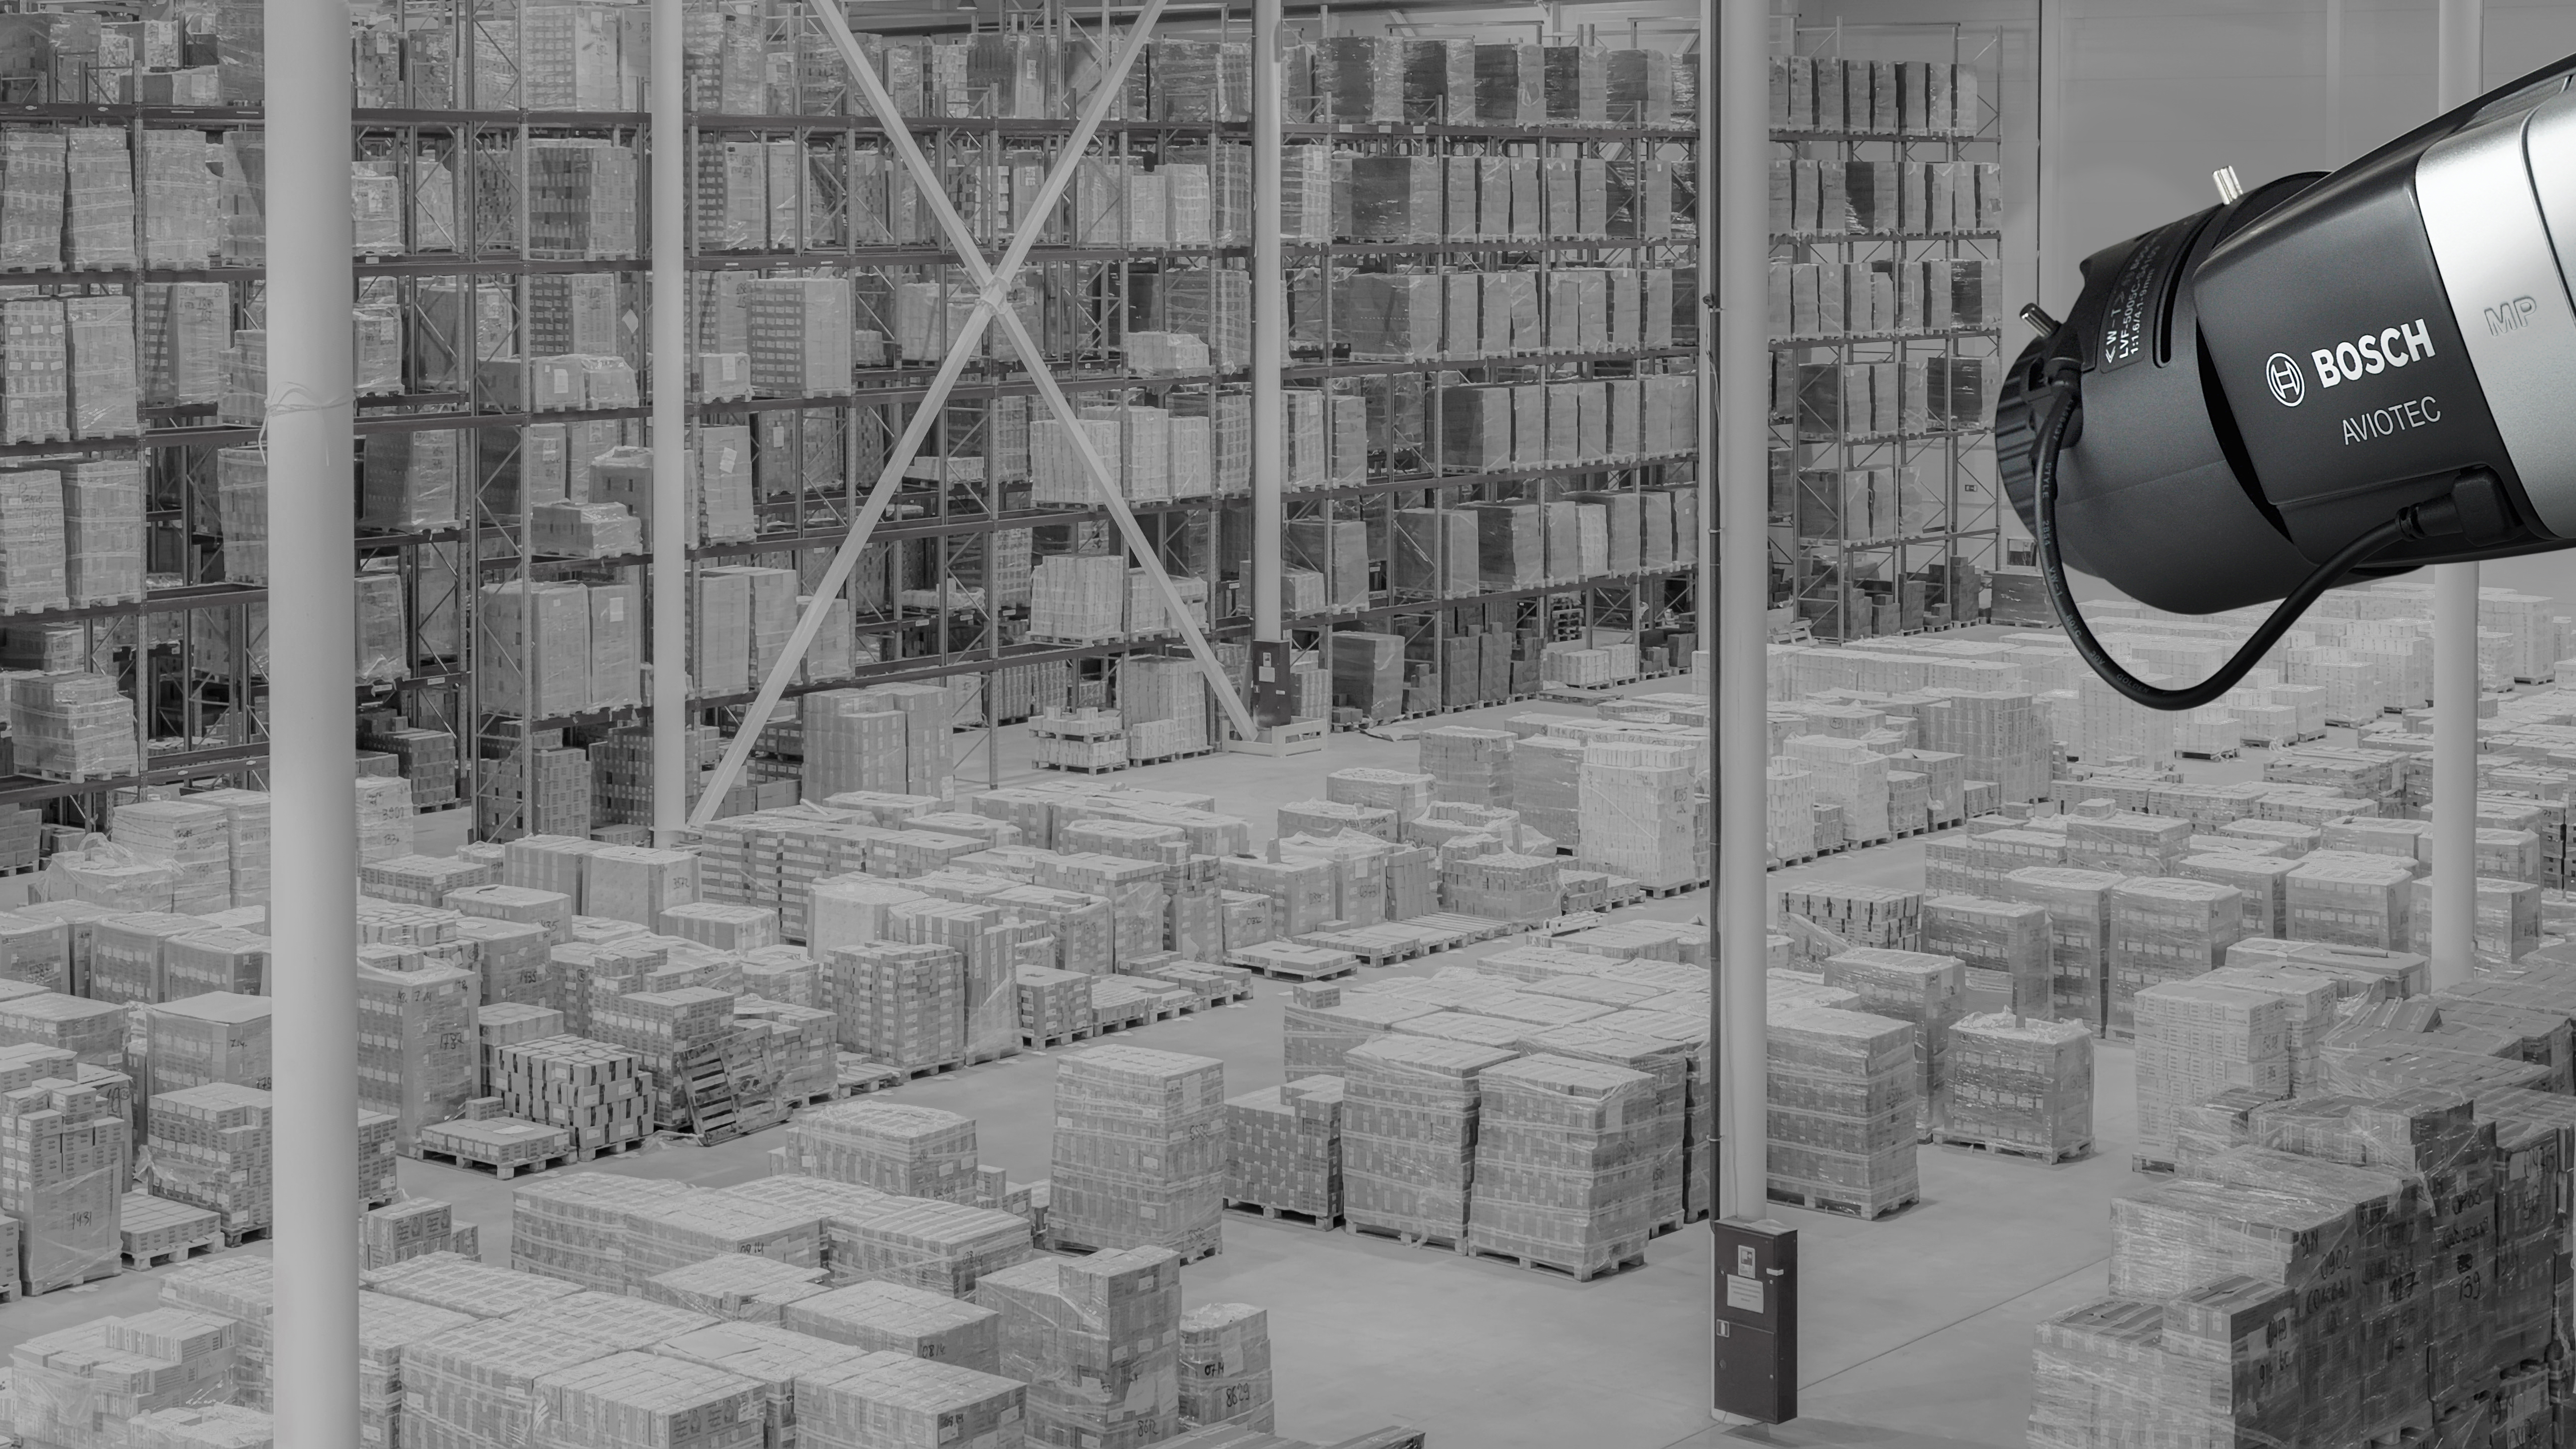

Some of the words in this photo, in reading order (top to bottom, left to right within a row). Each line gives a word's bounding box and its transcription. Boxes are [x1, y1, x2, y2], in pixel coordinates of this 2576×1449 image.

[2484, 296, 2537, 337] MP
[2311, 319, 2435, 388] BOSCH
[2342, 396, 2441, 445] AVIOTEC
[2042, 462, 2052, 499] STYLE
[2049, 566, 2063, 597] VW-1
[2089, 650, 2106, 666] 30V
[2116, 673, 2150, 694] GOLDEN
[72, 1211, 92, 1230] 1431
[1226, 1383, 1250, 1408] 8629
